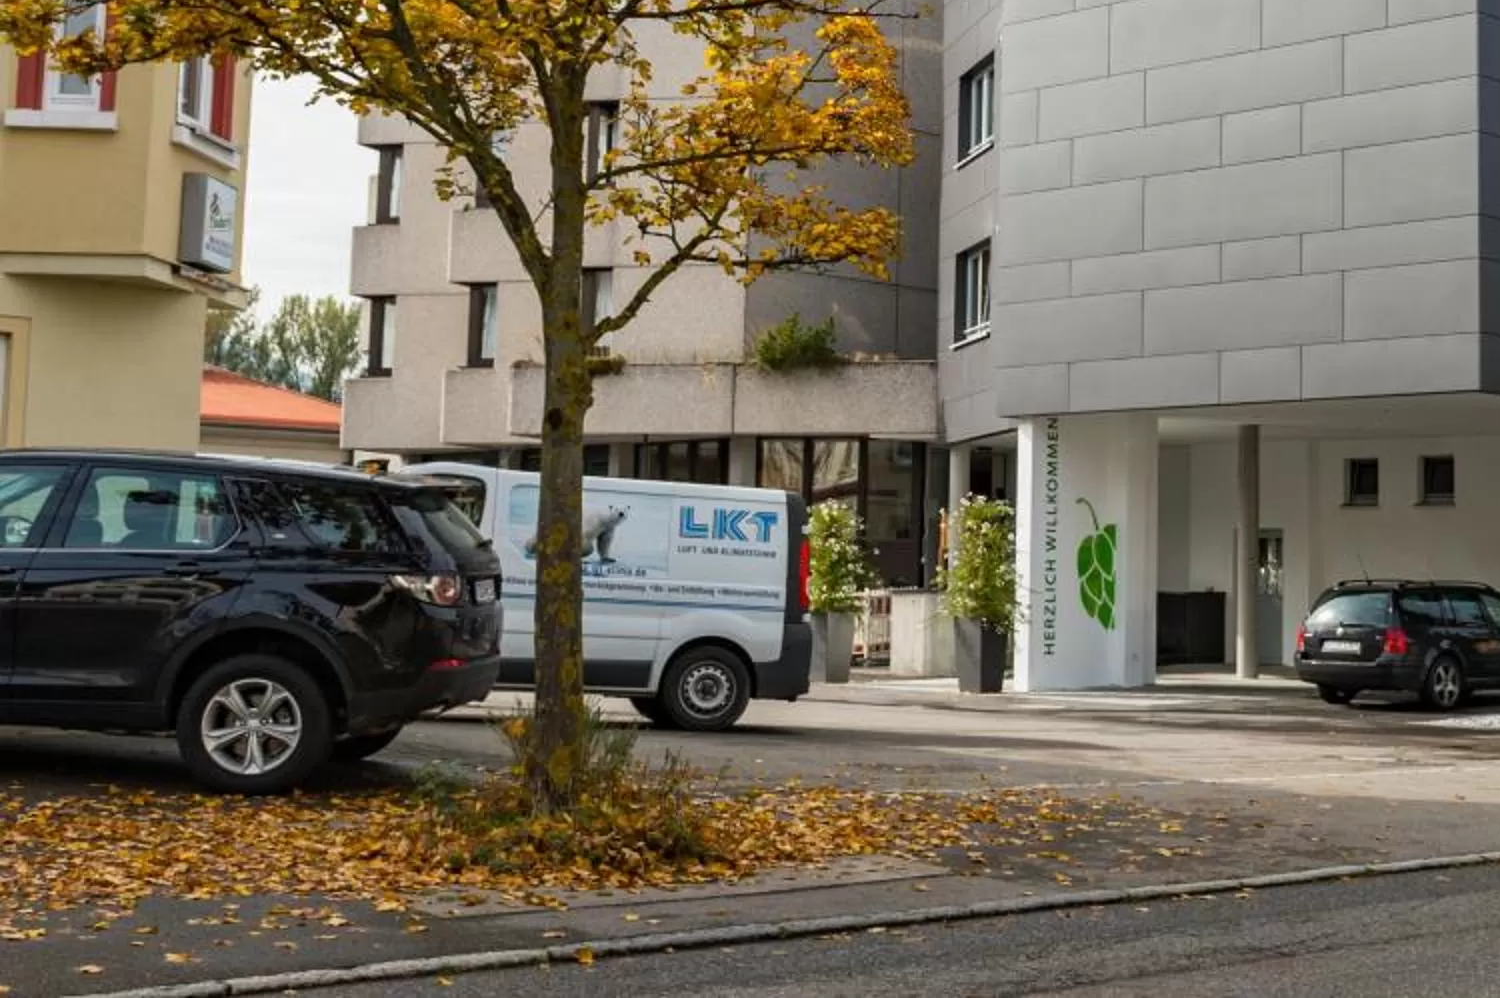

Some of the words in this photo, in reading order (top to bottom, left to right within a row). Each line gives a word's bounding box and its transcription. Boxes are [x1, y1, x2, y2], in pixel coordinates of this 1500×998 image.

[679, 504, 778, 543] LKT
[1044, 417, 1059, 553] WILLKOMMEN
[1043, 558, 1058, 656] HERZLICH
